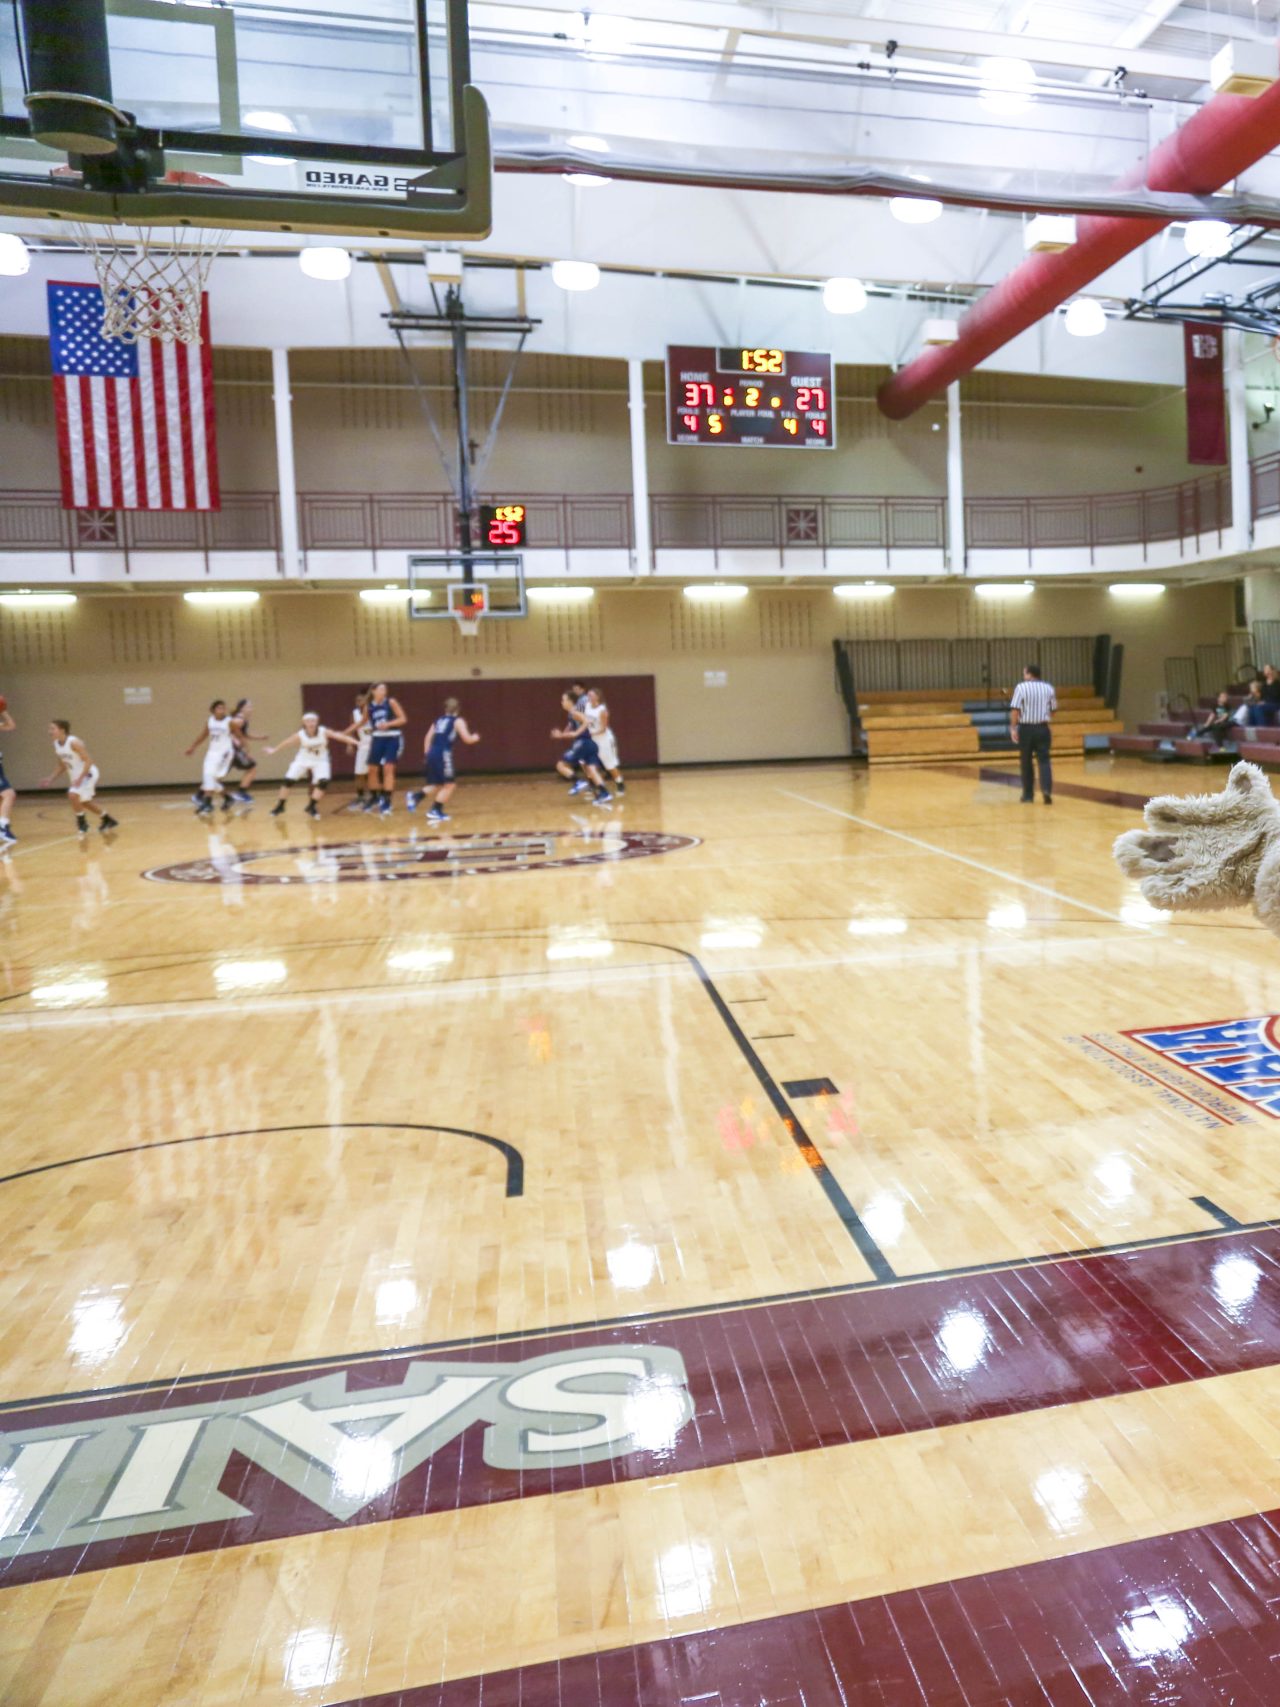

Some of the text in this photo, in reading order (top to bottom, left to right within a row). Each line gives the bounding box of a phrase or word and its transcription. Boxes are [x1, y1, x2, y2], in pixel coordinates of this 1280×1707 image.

[741, 349, 784, 373] 1:52
[680, 371, 710, 383] HOME
[790, 376, 822, 388] GUEST
[685, 383, 715, 406] 37
[745, 387, 760, 407] 2
[796, 388, 825, 411] 27
[684, 415, 697, 432] 4
[708, 414, 722, 434] 5
[783, 418, 798, 435] 4
[812, 419, 825, 436] 4
[489, 520, 519, 544] 25
